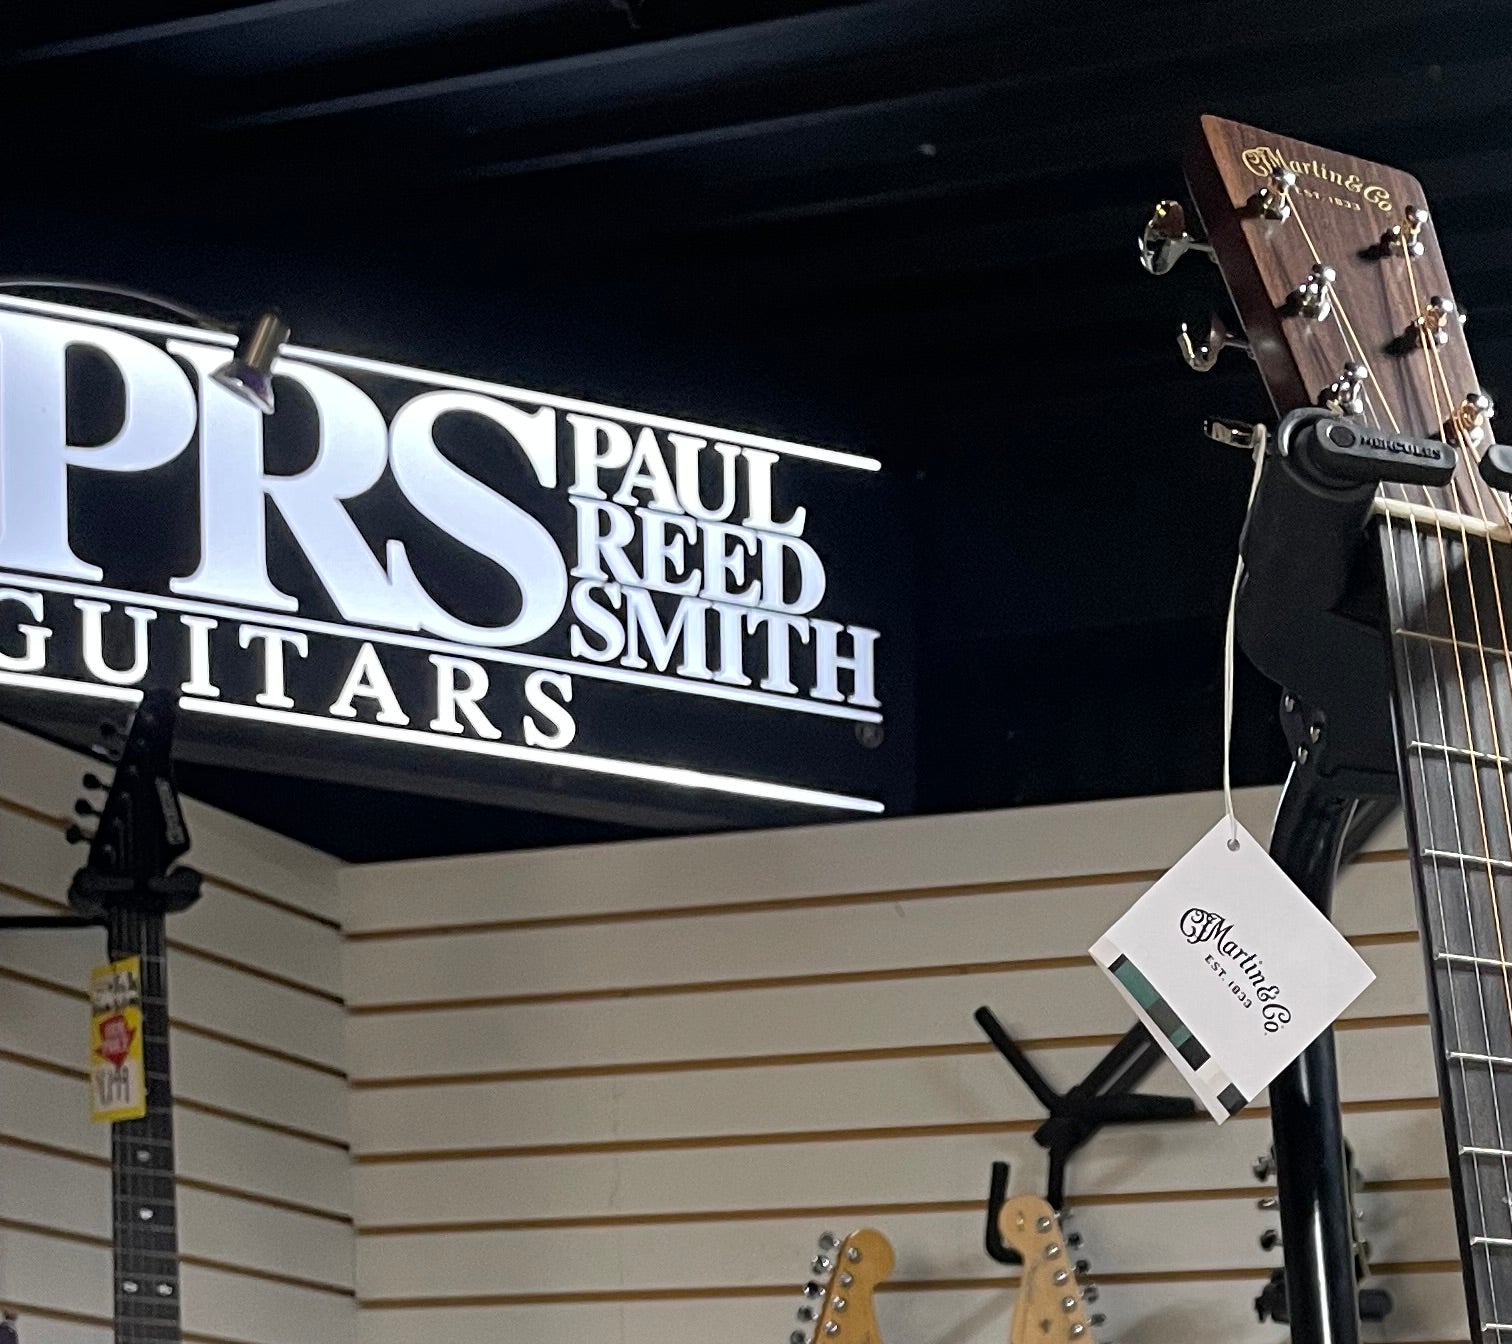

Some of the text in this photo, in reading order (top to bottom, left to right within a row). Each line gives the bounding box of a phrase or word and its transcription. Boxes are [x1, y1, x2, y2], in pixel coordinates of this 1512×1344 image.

[0, 308, 569, 647] PRS
[566, 413, 807, 537] PAUL
[569, 496, 826, 615] REED
[0, 588, 577, 750] GUITARS
[570, 578, 882, 708] SMITH
[1227, 981, 1253, 1009] 1833
